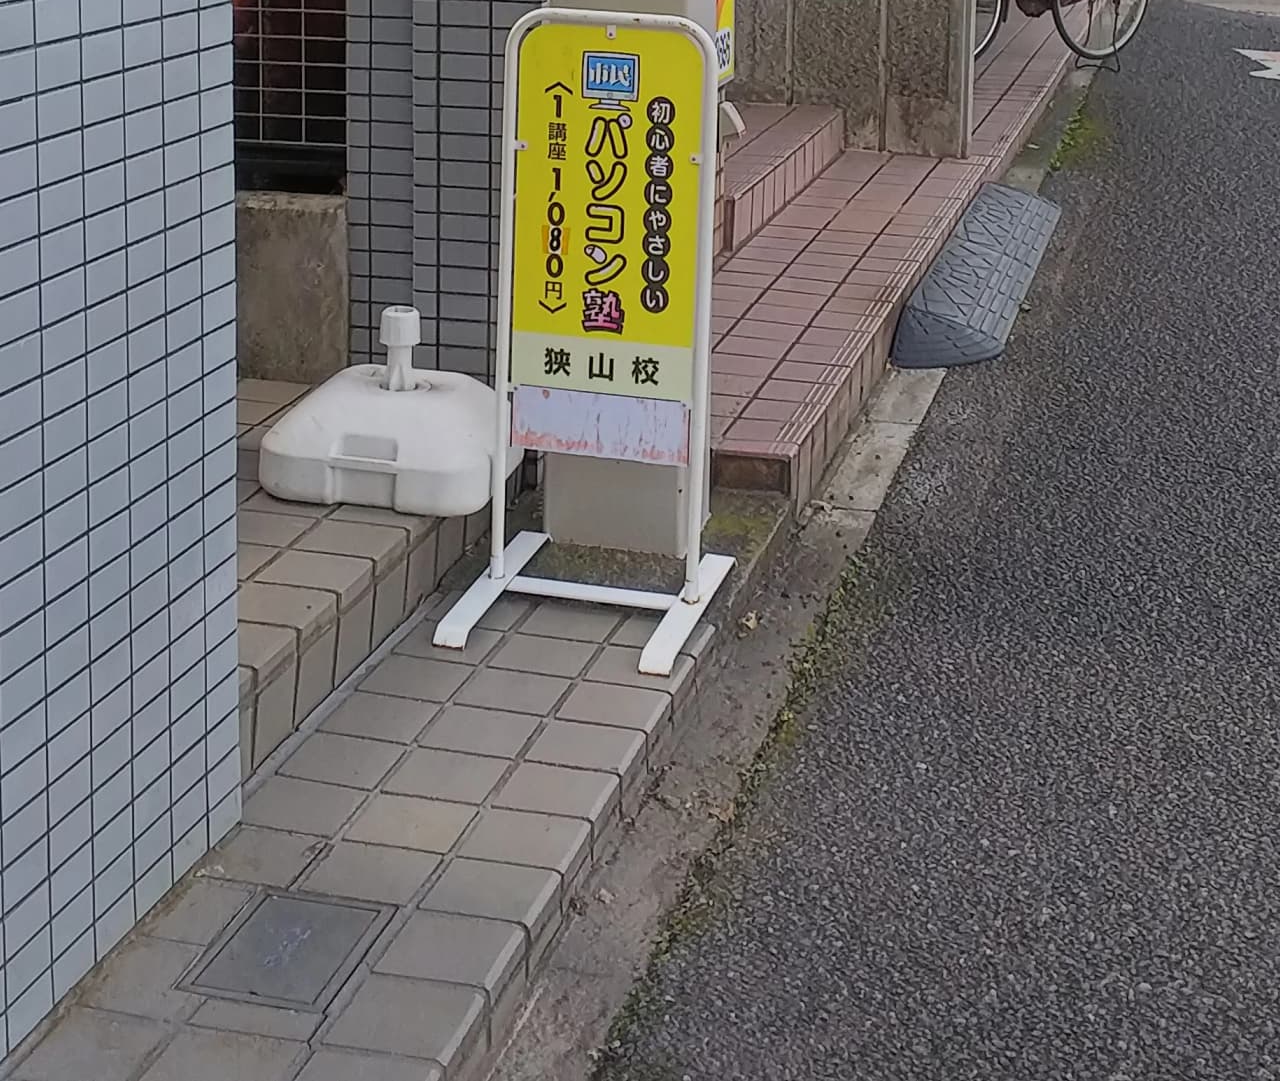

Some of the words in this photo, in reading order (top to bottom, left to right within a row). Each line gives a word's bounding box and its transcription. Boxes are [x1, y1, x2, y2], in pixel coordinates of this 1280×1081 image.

[589, 62, 631, 87] 市民
[581, 112, 633, 335] パソコン塾
[643, 98, 674, 311] 初心者にやさしい
[543, 347, 660, 386] 狭山校
